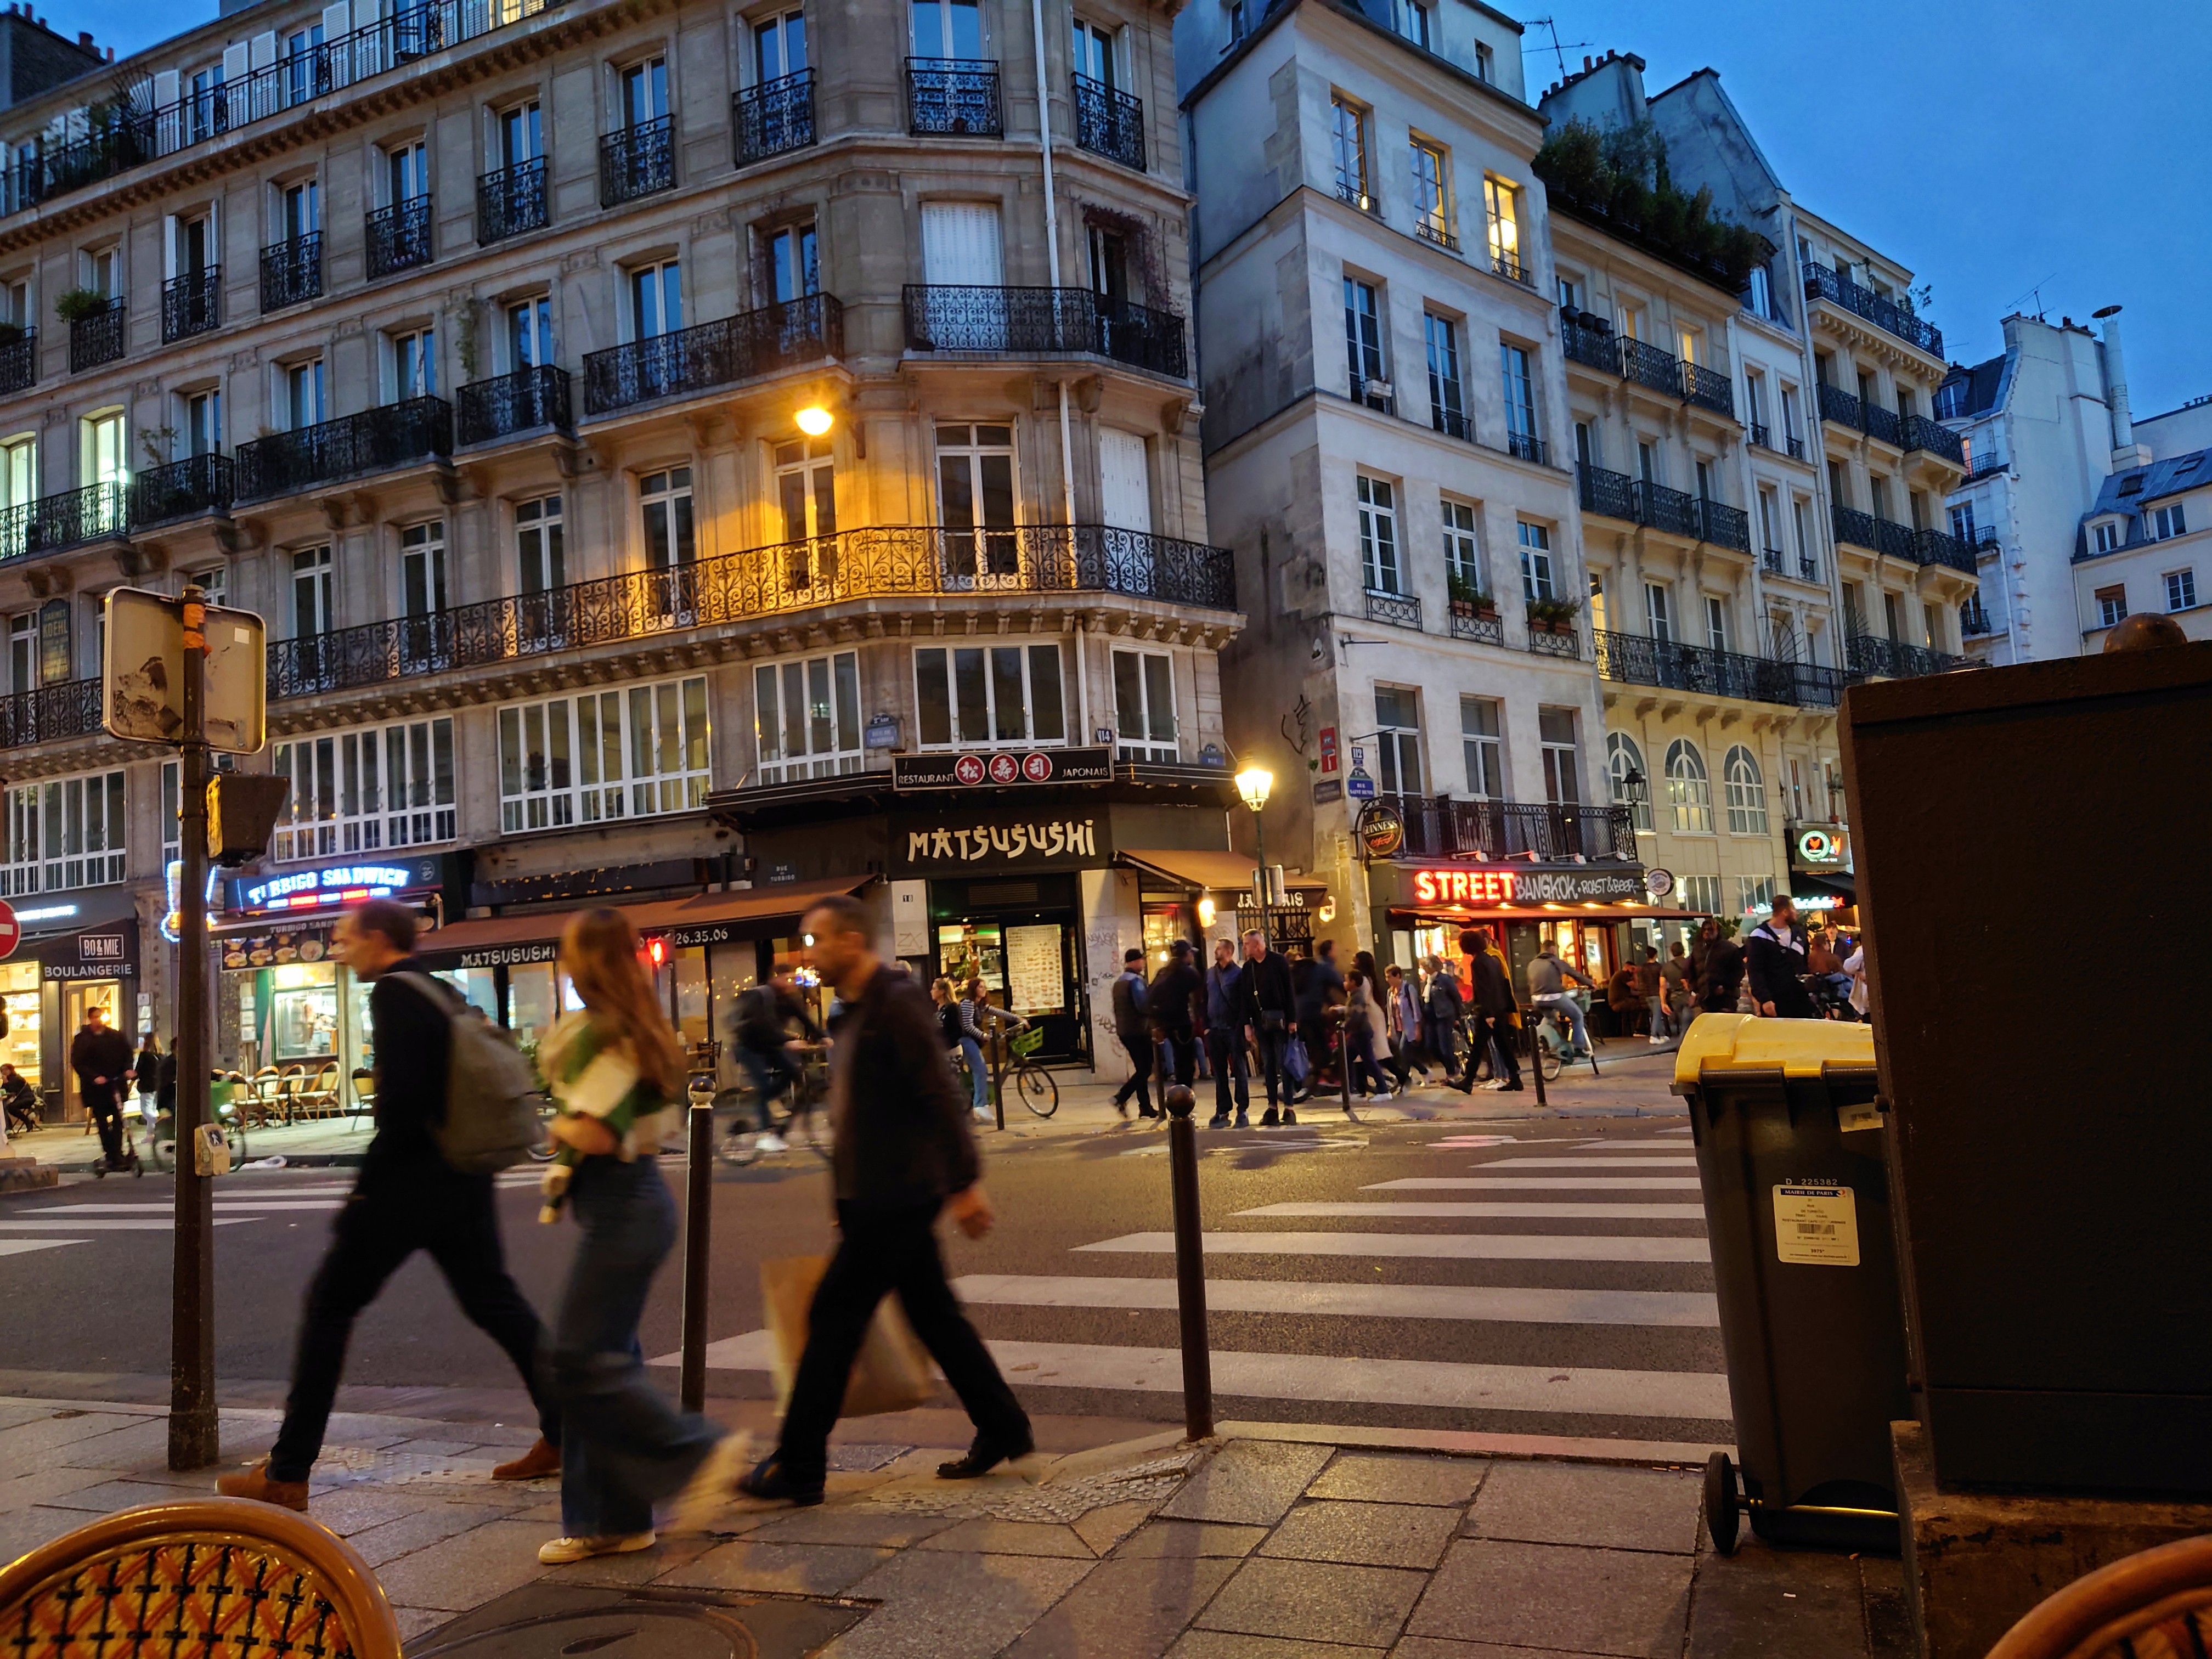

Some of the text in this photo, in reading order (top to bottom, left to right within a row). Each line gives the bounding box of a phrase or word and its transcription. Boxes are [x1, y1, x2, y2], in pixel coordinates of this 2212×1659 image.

[43, 619, 68, 637] KOEHL
[1099, 730, 1110, 741] 114
[1353, 748, 1362, 758] 112
[898, 773, 954, 785] RESTAURANT
[1062, 767, 1109, 778] JAPONAIS
[1364, 820, 1398, 835] GUINNESS
[1415, 871, 1515, 901] STREET
[1514, 874, 1578, 901] BANGKOK
[270, 923, 307, 934] TURBIGO
[461, 946, 567, 968] MATSUSUSHI
[44, 963, 133, 978] BOULANGERIE
